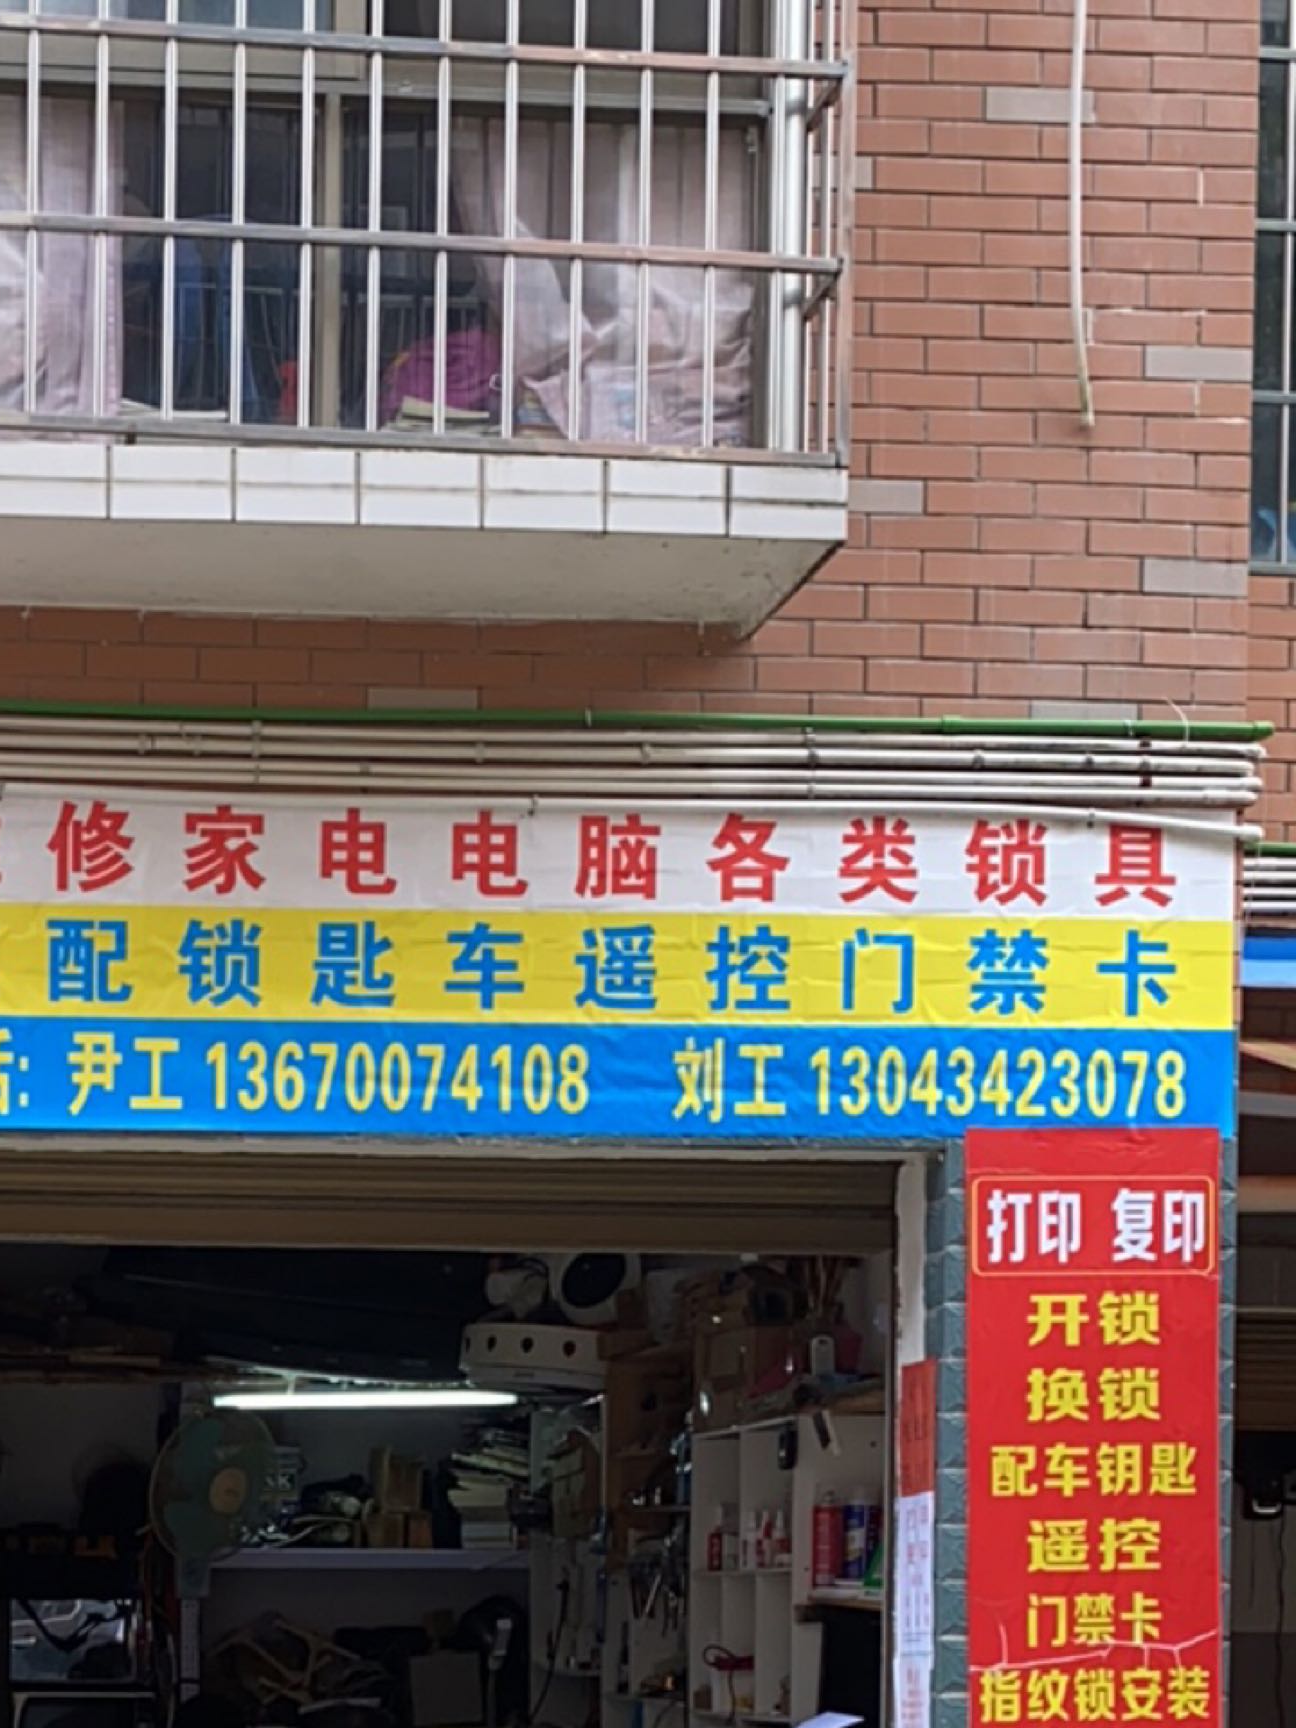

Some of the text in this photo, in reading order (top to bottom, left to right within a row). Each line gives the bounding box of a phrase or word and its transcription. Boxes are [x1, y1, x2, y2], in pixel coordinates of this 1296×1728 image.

[67, 1031, 183, 1115] 尹工
[205, 1041, 590, 1115] 13670074108
[672, 1037, 787, 1122] 刘工
[810, 1045, 1187, 1118] 13043423078
[986, 1187, 1204, 1264] 打印 复印
[1026, 1290, 1161, 1346] 开锁
[1026, 1366, 1162, 1422] 换锁
[990, 1441, 1198, 1497] 配车钥匙
[1027, 1517, 1162, 1573] 遥控
[1027, 1591, 1163, 1648] 门禁卡
[979, 1665, 1211, 1724] 指纹锁安装
